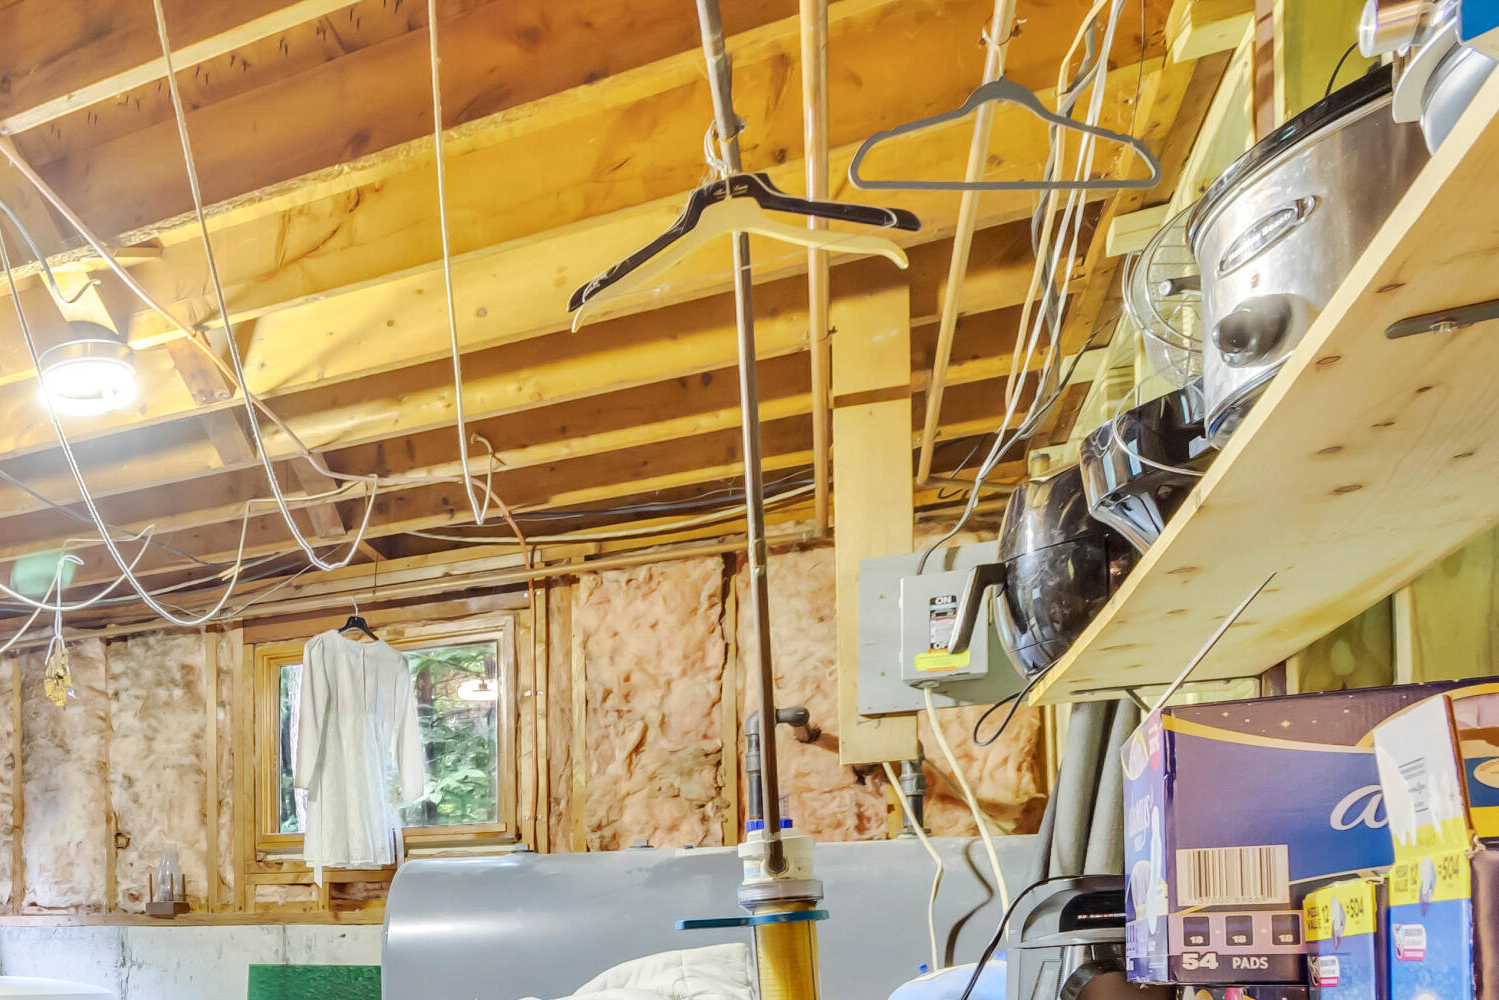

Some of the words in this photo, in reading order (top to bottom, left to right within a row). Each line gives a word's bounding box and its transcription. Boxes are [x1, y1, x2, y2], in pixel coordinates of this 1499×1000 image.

[935, 595, 951, 604] ON
[1181, 952, 1219, 970] 54
[1232, 956, 1269, 970] PADS
